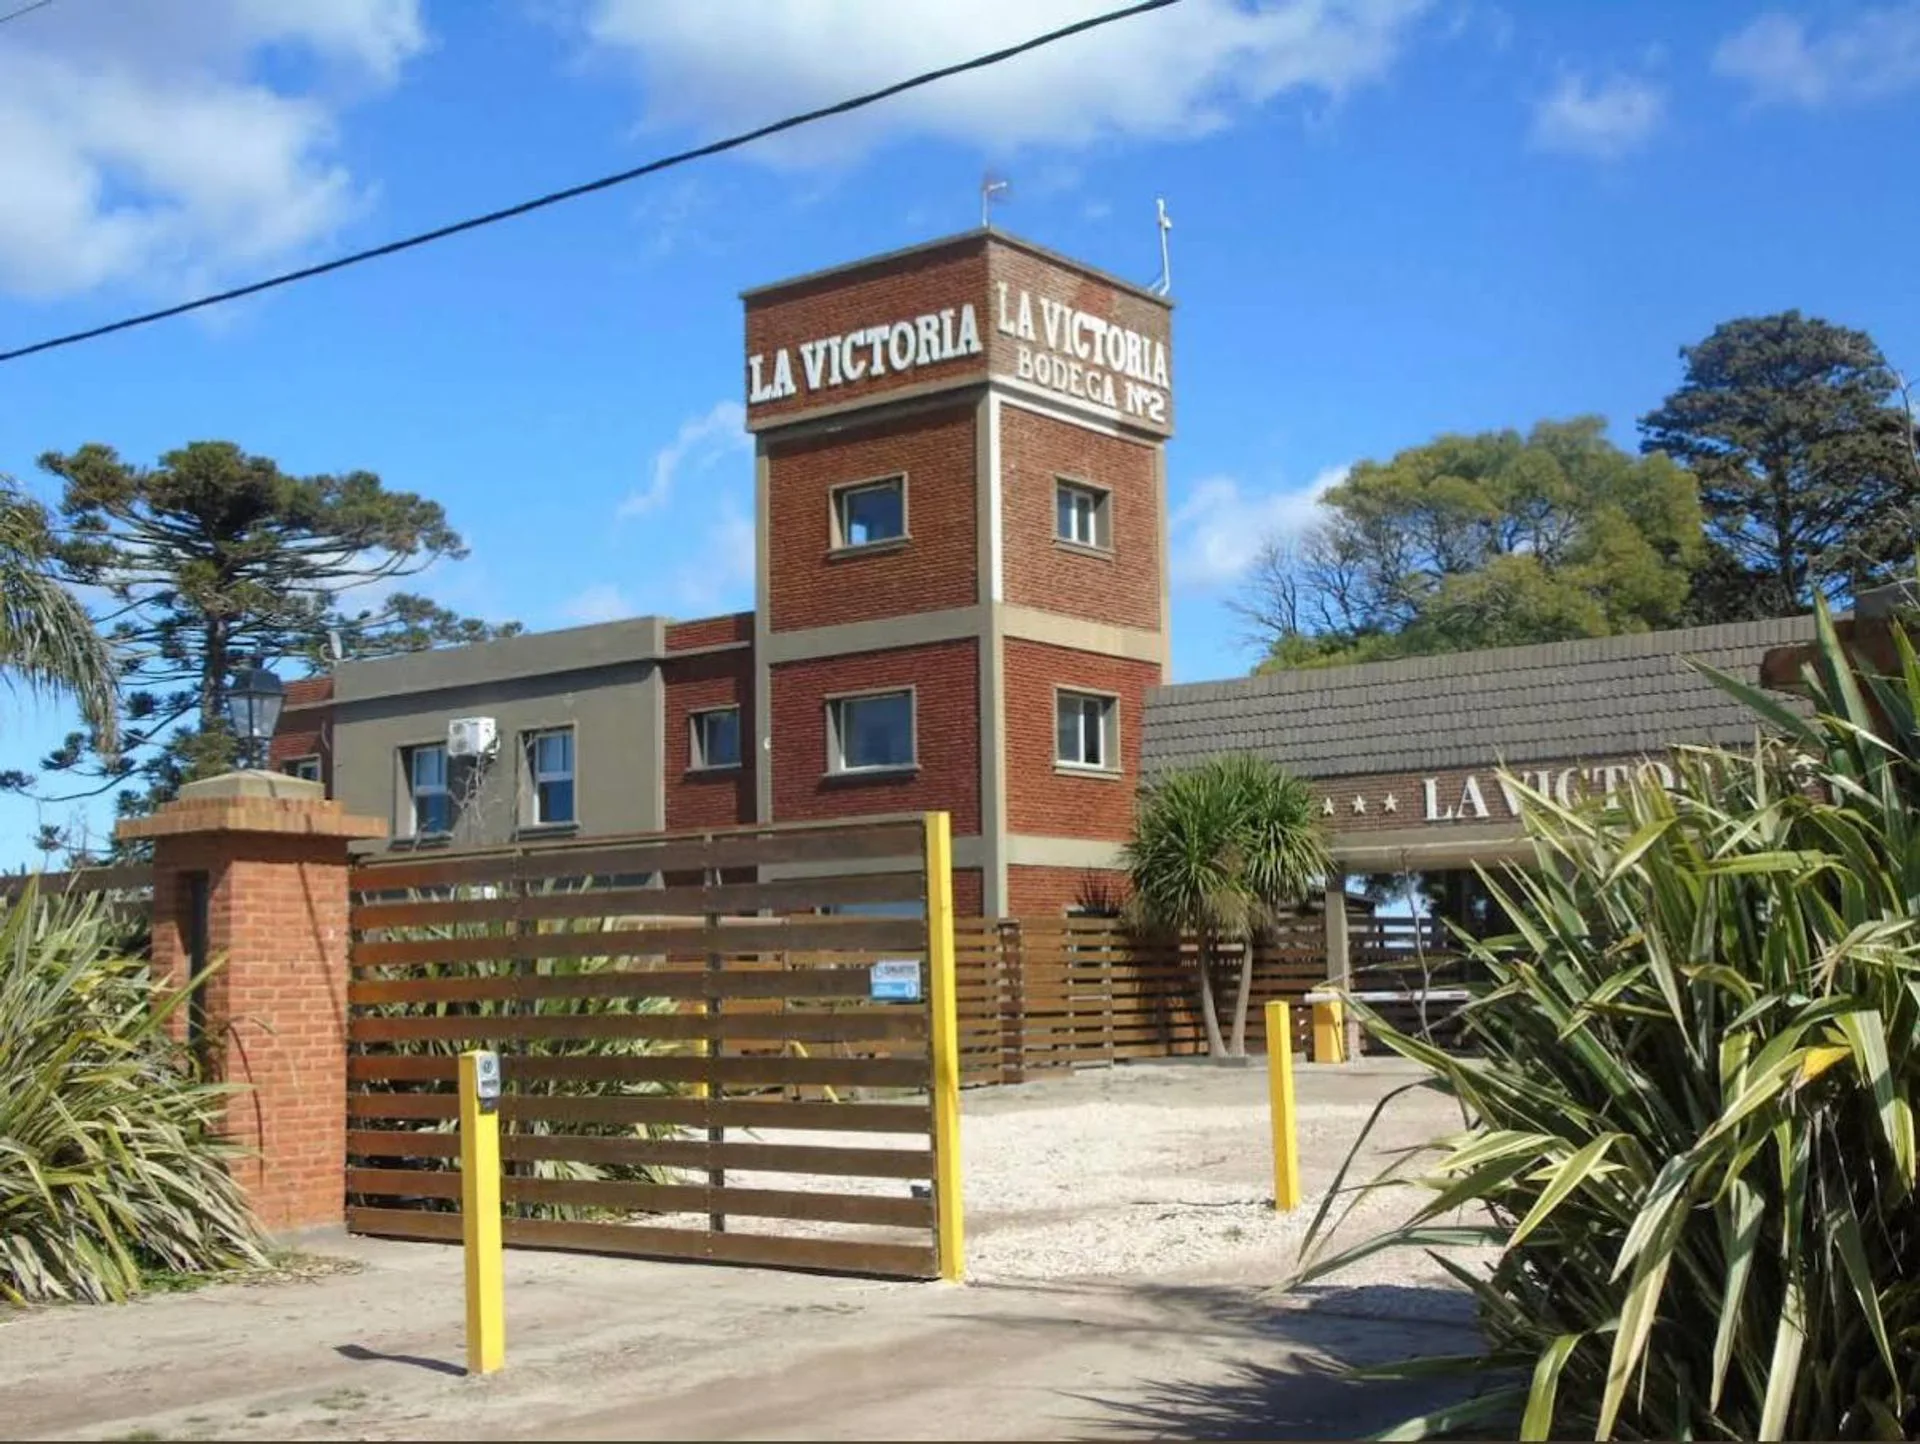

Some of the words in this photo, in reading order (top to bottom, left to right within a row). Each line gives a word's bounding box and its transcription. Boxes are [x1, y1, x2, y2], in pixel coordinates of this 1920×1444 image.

[749, 348, 797, 404] LA
[800, 304, 983, 390] VICTORIA
[997, 281, 1036, 341] LA
[1040, 297, 1169, 389] VICTORIA
[1016, 345, 1117, 407] BODEGA
[1423, 775, 1490, 820] LA
